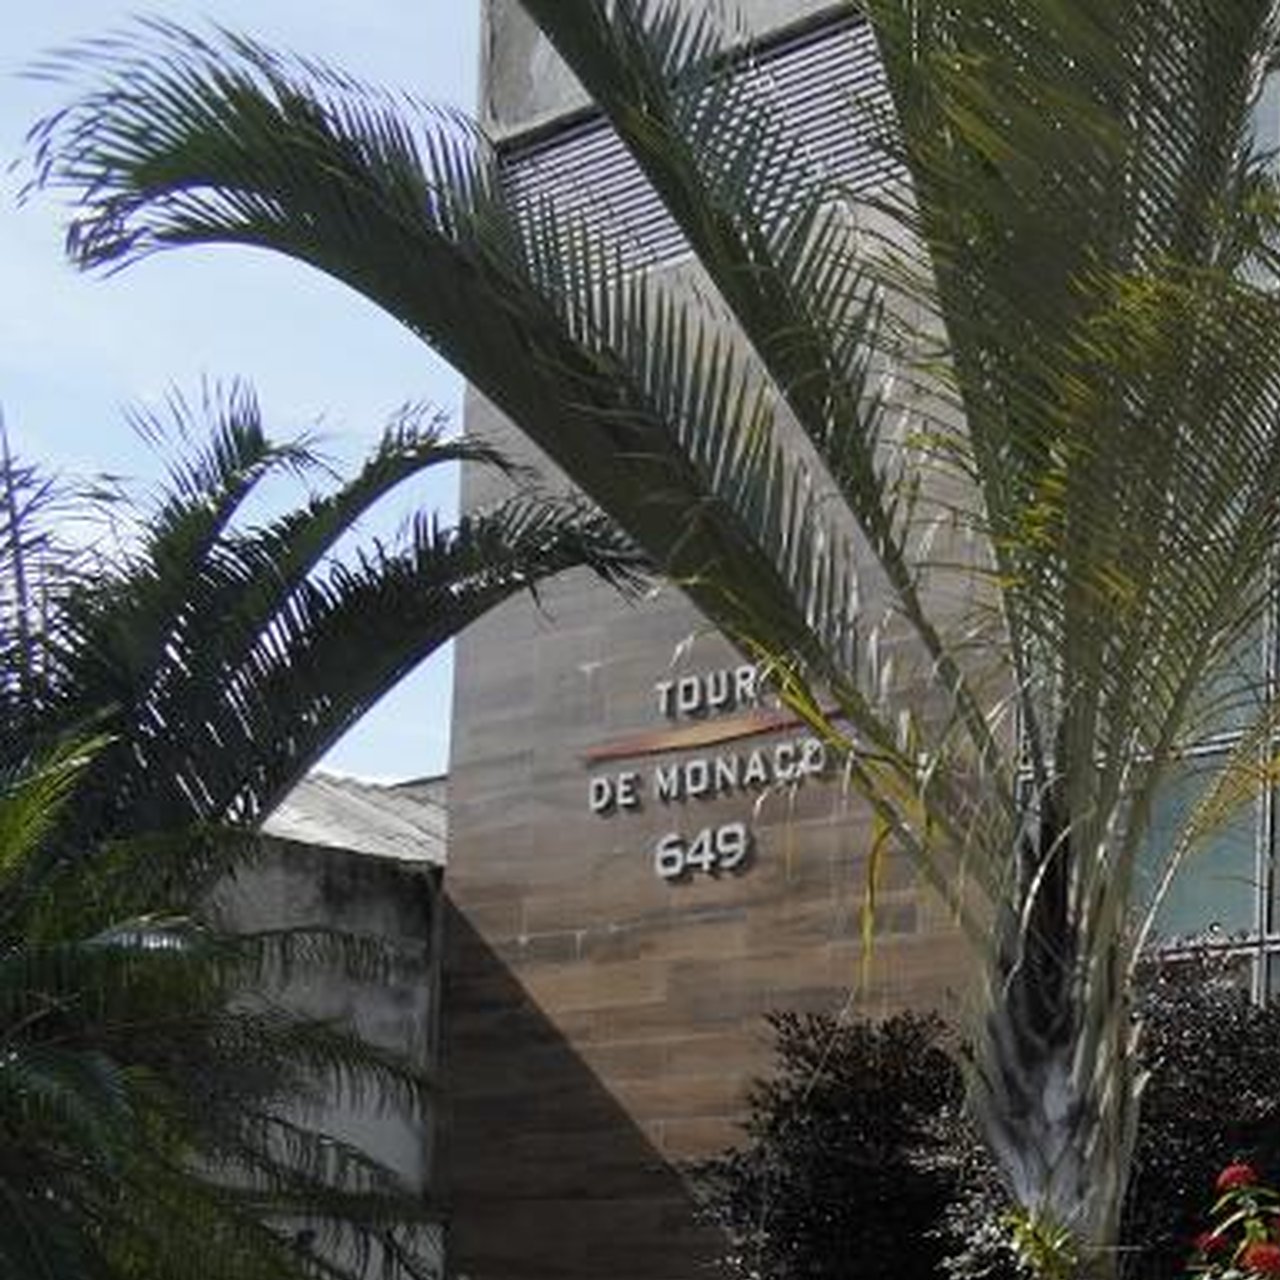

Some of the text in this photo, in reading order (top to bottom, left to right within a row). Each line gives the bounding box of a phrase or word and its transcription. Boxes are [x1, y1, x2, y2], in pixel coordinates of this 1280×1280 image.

[656, 664, 757, 712] TOUR
[589, 738, 825, 810] DE MONACO
[656, 823, 748, 878] 649
